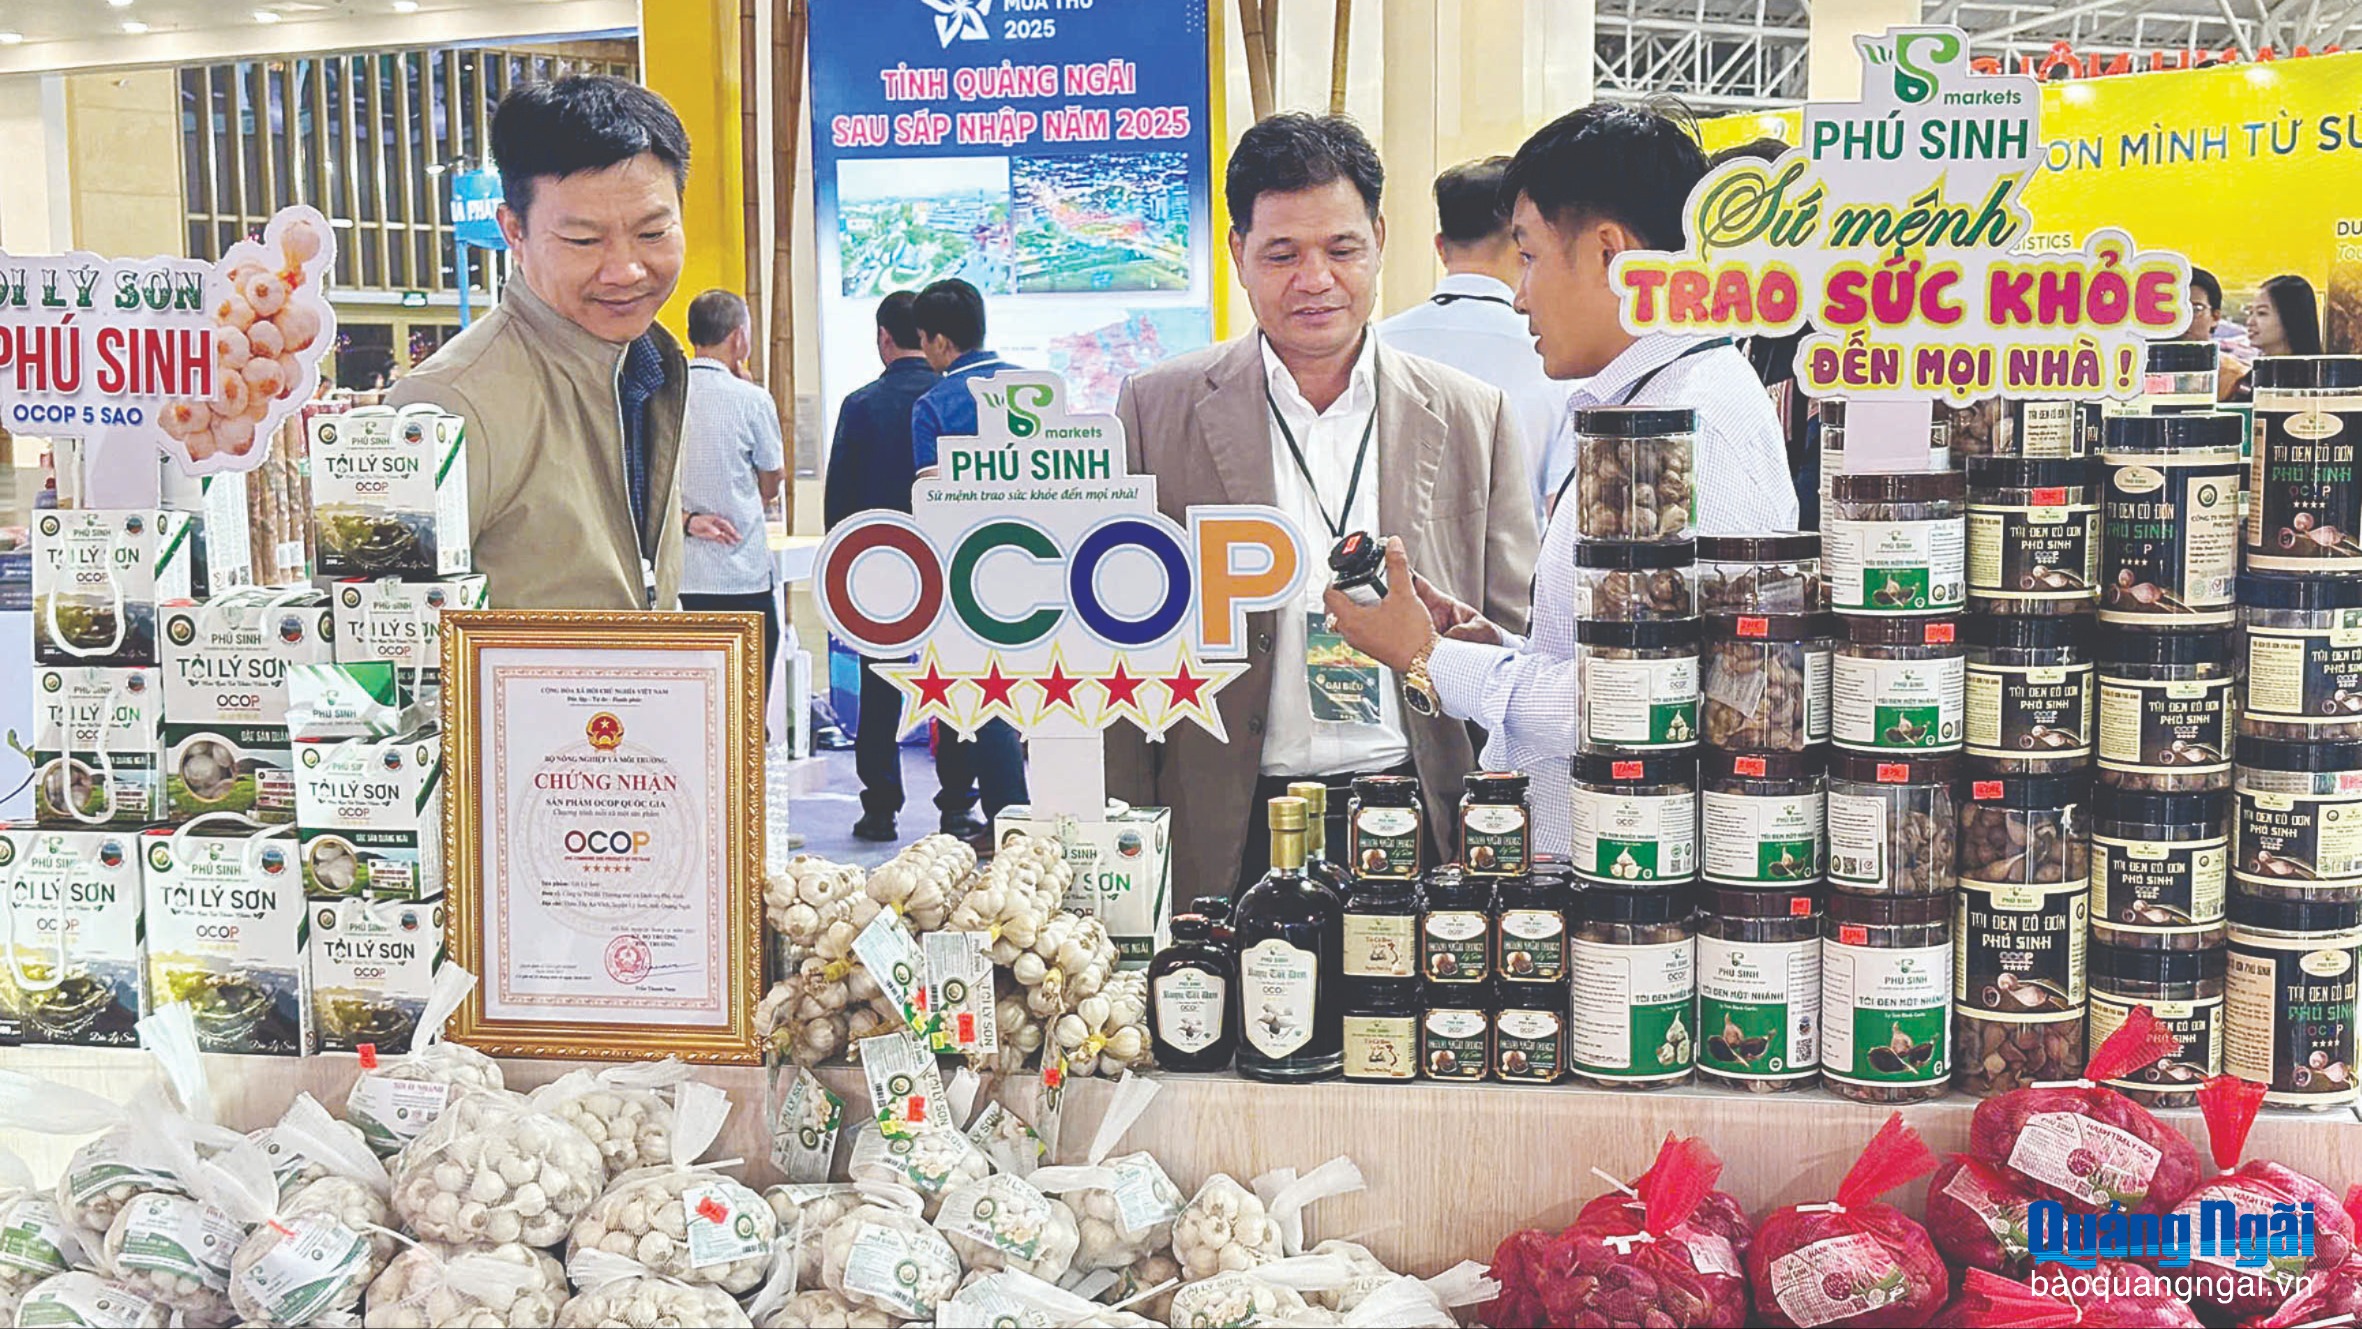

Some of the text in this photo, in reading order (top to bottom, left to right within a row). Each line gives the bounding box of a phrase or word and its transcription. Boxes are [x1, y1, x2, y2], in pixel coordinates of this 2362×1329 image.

[1004, 18, 1056, 39] 2025
[882, 60, 1136, 101] TỈNH QUẢNG NGÃI
[1944, 90, 2022, 105] markets
[832, 105, 1190, 147] SAU SẤP NHẬP NĂM 2025
[1812, 109, 2028, 160] PHÚ SINH
[2045, 137, 2102, 171] ƠN
[2120, 123, 2227, 166] MÌNH
[2244, 110, 2303, 156] TỪ
[1701, 163, 2017, 262] Sứ mệnh
[41, 264, 203, 311] LÝ SƠN
[1624, 250, 2177, 324] TRAO SỨC KHỎE
[97, 327, 212, 395] SINH
[1810, 330, 1899, 385] ĐẾN
[1917, 349, 1990, 393] MỌI
[2010, 341, 2099, 387] NHÀ
[13, 403, 144, 427] OCOP 5 SAO
[1045, 426, 1102, 438] markets
[2292, 446, 2312, 462] ĐEN
[2334, 445, 2353, 462] ĐƠN
[359, 453, 379, 472] LÝ
[382, 456, 418, 473] SƠN
[952, 443, 1110, 482] PHÚ SINH
[2272, 464, 2351, 482] PHÚ SINH
[355, 481, 389, 492] OCOP
[945, 488, 978, 503] mệnh
[981, 490, 1005, 500] trao
[1008, 486, 1027, 501] sức
[1063, 486, 1083, 500] đến
[1086, 487, 1109, 502] mọi
[1111, 486, 1138, 500] nhà!
[2029, 526, 2048, 538] ĐEN
[2134, 525, 2174, 539] SINH
[2021, 539, 2071, 549] PHÚ SINH
[47, 545, 140, 564] TI LÝ ƠN
[825, 519, 1298, 646] OCOP
[211, 633, 261, 645] PHÚ SINH
[378, 645, 412, 656] OCOP
[2332, 651, 2350, 661] ĐEN
[219, 654, 243, 678] LÝ
[248, 657, 292, 679] SƠN
[216, 694, 260, 707] OCOP
[2029, 687, 2047, 698] ĐEN
[2020, 698, 2069, 709] PHÚ SINH
[2169, 701, 2188, 712] ĐEN
[2160, 713, 2210, 725] PHÚ SINH
[340, 779, 359, 798] LÝ
[363, 783, 400, 800] SƠN
[534, 769, 677, 795] CHỨNG NHẬN
[337, 806, 370, 817] OCOP
[594, 799, 620, 808] OCOP
[649, 799, 667, 809] GIA
[2250, 823, 2297, 838] PHÚ SINH
[564, 830, 651, 854] OCOP
[1071, 849, 1097, 860] SINH
[191, 863, 242, 876] PHÚ SINH
[2129, 861, 2147, 872] ĐEN
[2122, 874, 2174, 886] PHÚ SINH
[14, 876, 35, 901] ỎI
[70, 882, 116, 903] SƠN
[201, 884, 224, 908] LÝ
[231, 889, 277, 911] SƠN
[1992, 915, 2017, 931] ĐEN
[2044, 914, 2066, 931] ĐƠN
[196, 925, 240, 939] OCOP
[1982, 932, 2051, 949] PHÚ SINH
[356, 939, 373, 958] LÝ
[379, 942, 415, 959] SƠN
[354, 966, 386, 978] OCOP
[1907, 975, 1928, 985] SINH
[1751, 989, 1784, 1000] NHÁNH
[2309, 986, 2328, 1002] ĐEN
[2172, 1034, 2197, 1043] SINH
